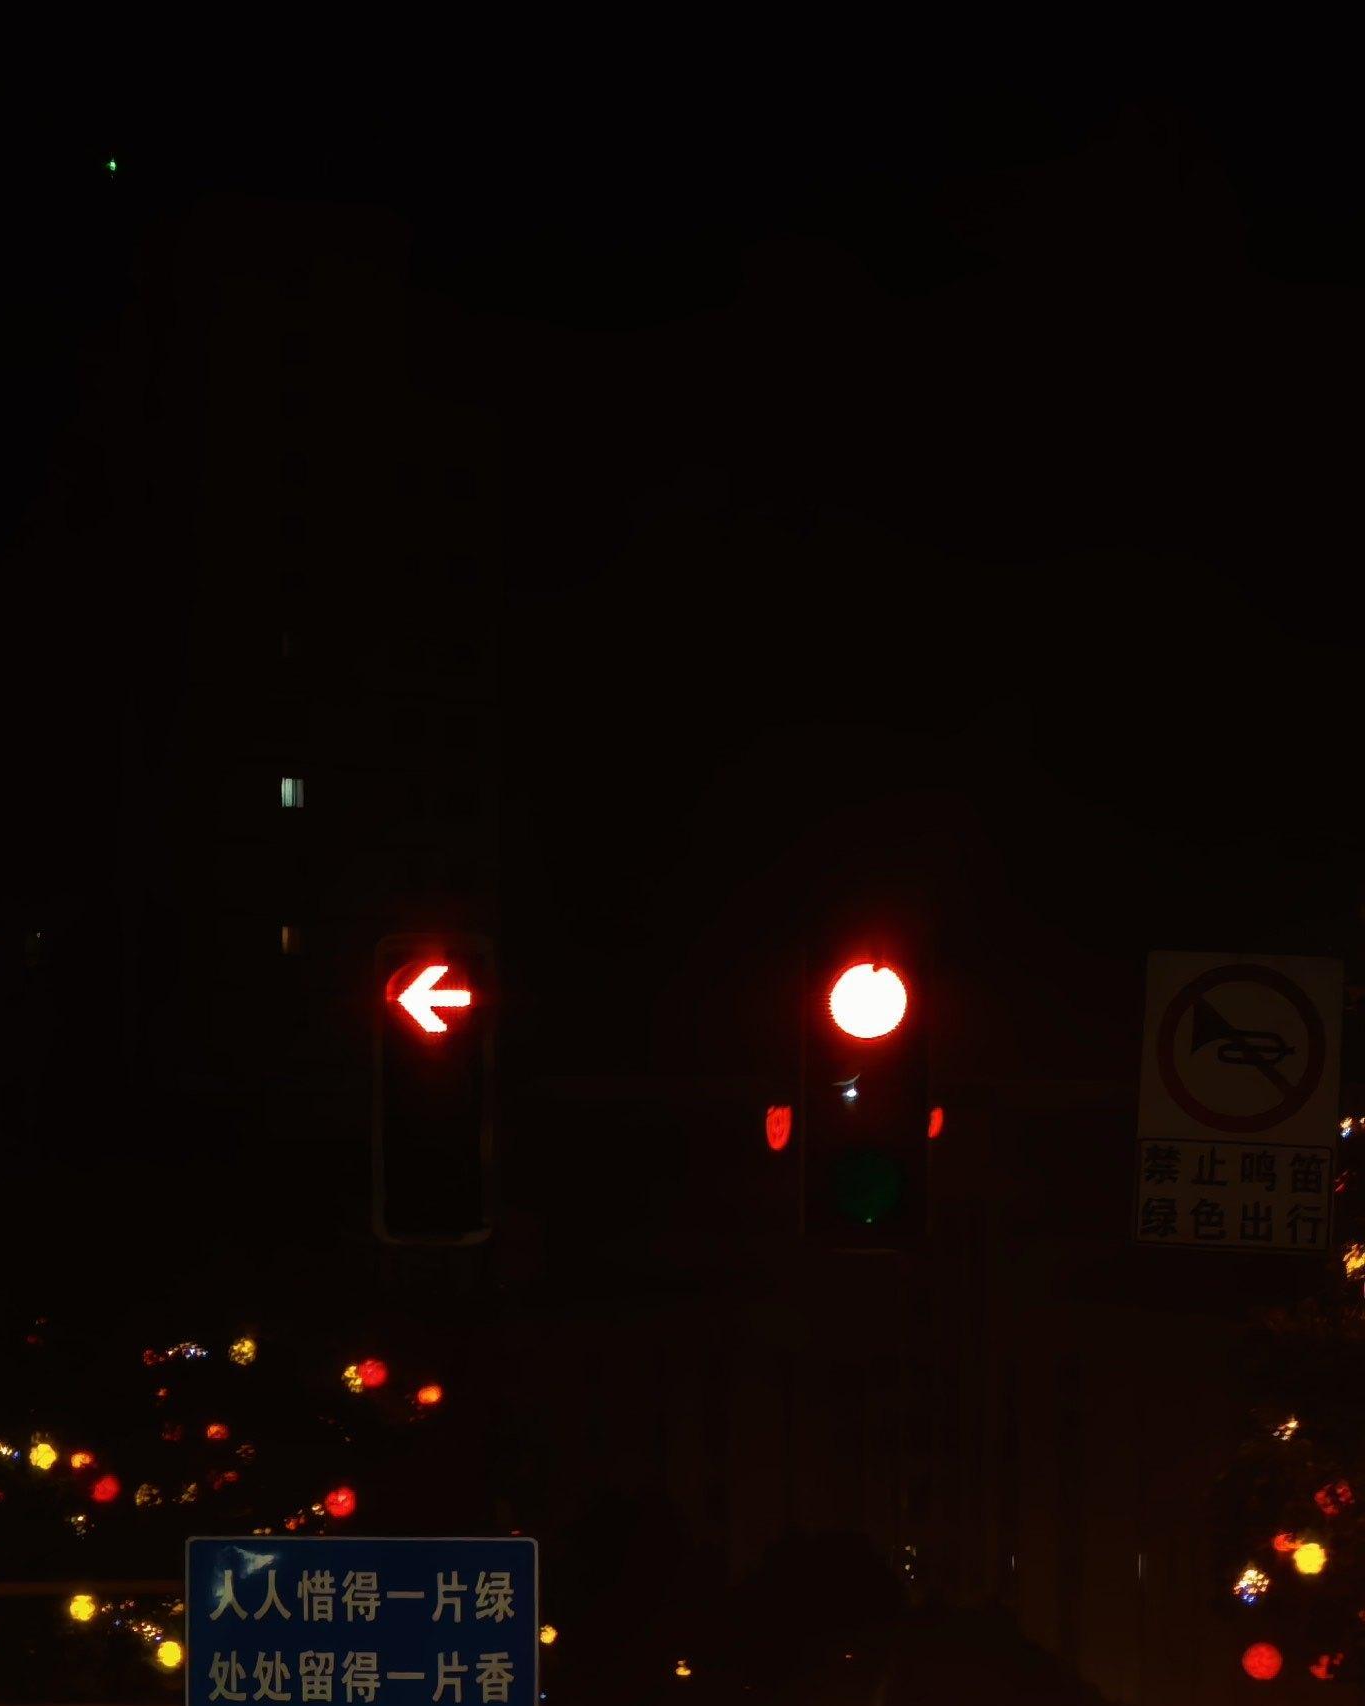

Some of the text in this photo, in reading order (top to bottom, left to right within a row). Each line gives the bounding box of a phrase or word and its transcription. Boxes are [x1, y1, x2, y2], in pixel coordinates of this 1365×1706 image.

[1143, 1143, 1327, 1193] 禁止鸣笛
[1140, 1197, 1323, 1244] 绿色出行
[209, 1568, 516, 1623] 人人惜得一片绿
[208, 1650, 516, 1704] 处处留得一片香
